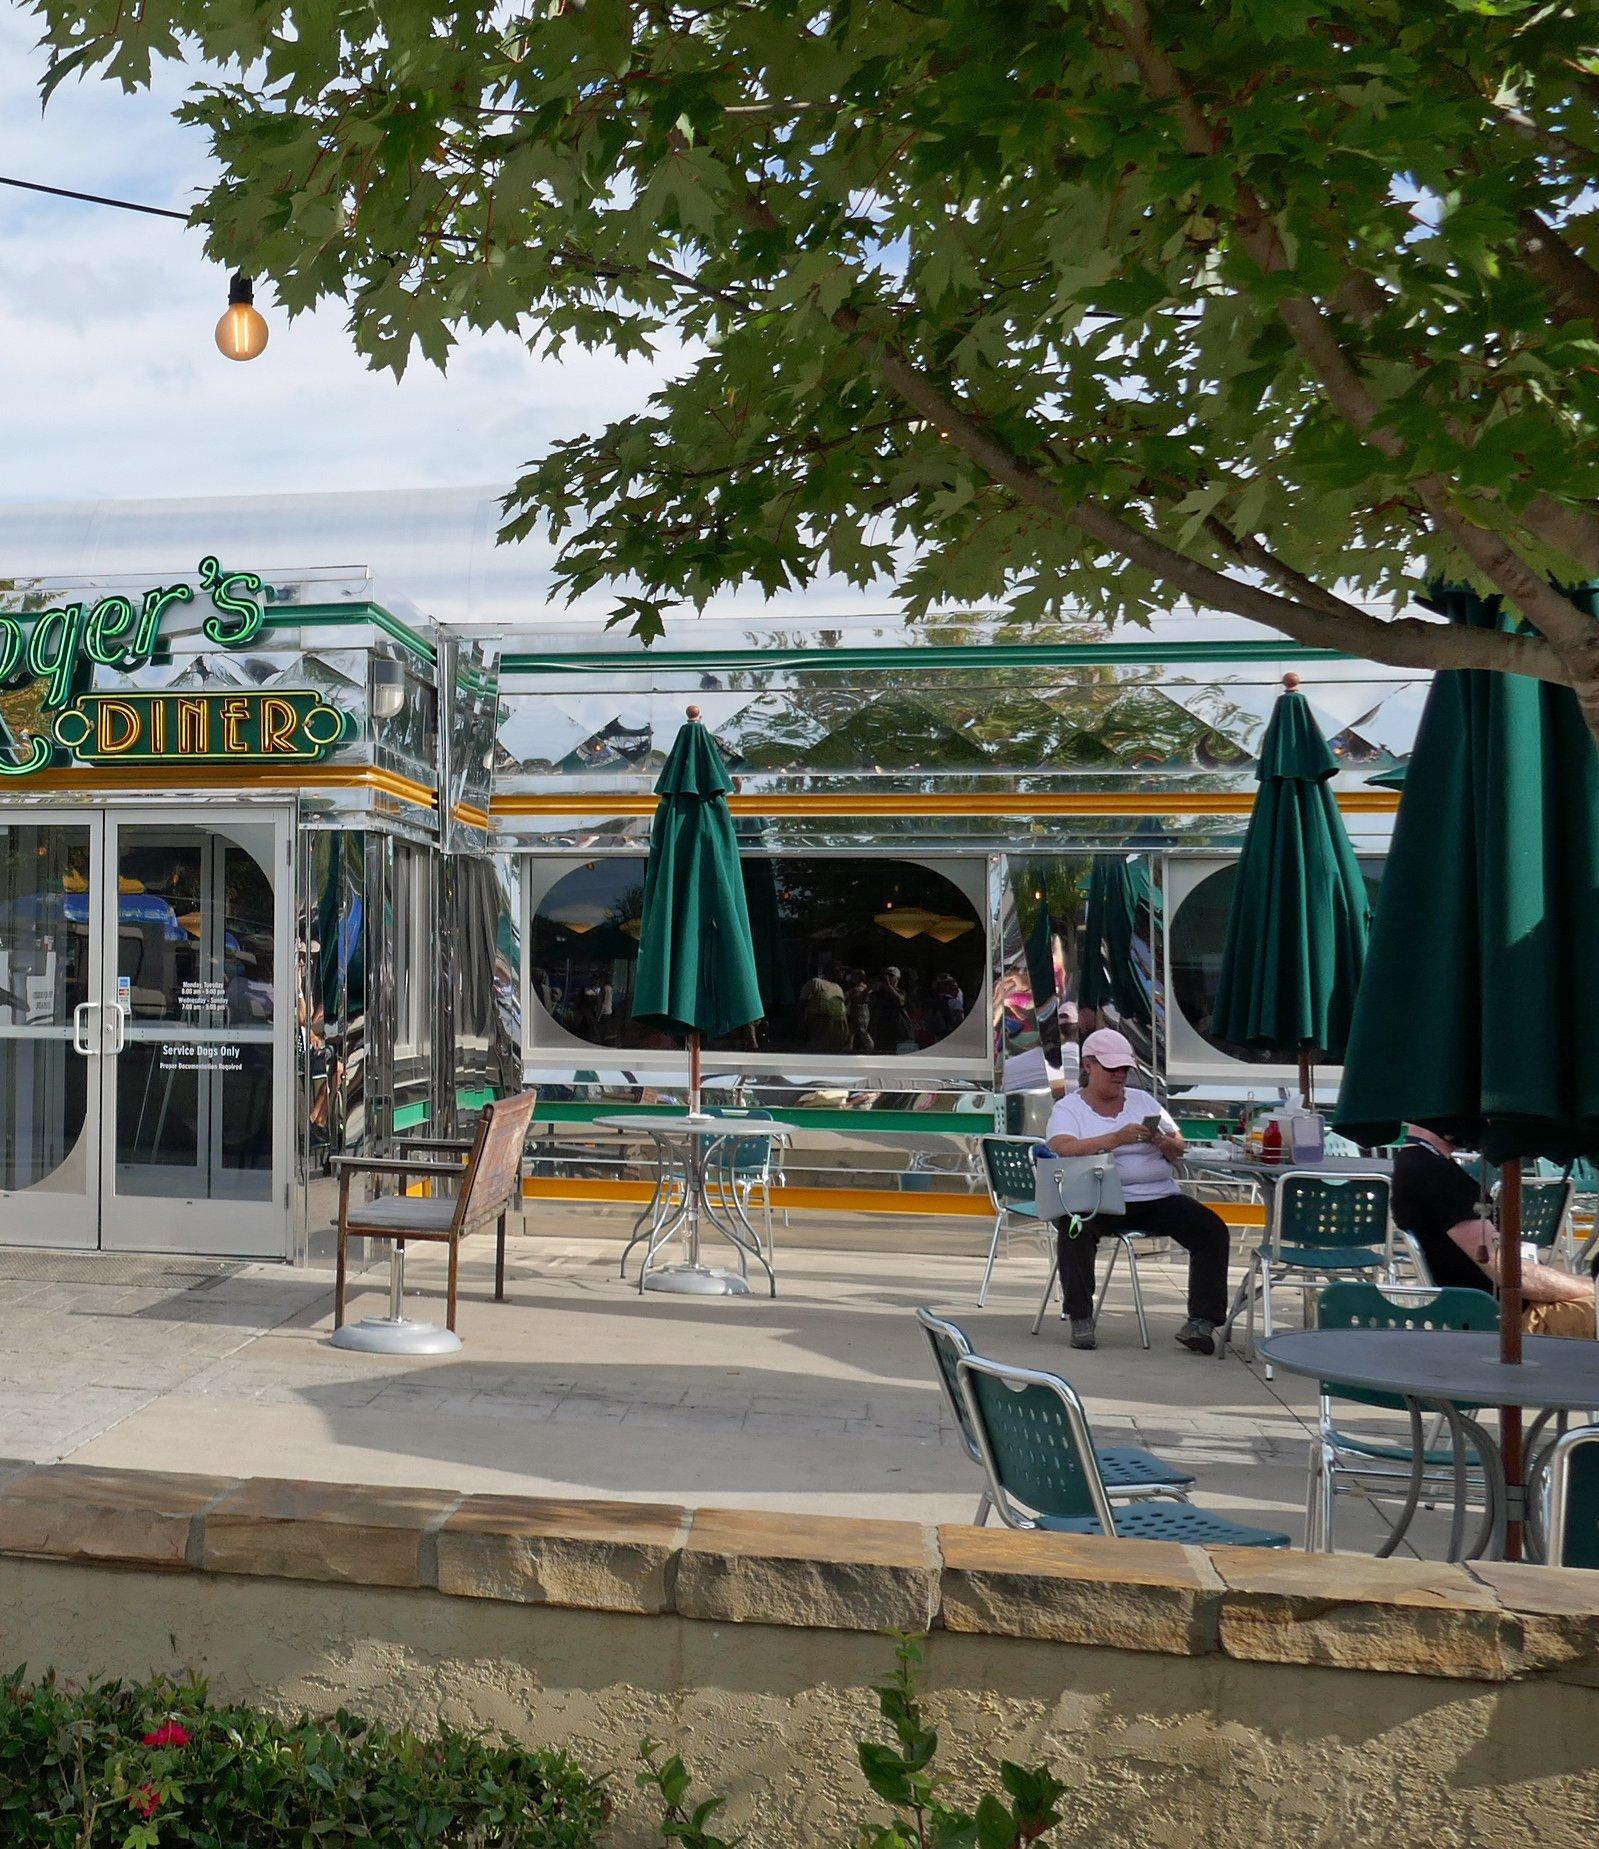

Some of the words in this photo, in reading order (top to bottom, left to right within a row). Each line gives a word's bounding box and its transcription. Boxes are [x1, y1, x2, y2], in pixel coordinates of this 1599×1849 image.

[96, 697, 300, 756] DINER
[162, 1045, 195, 1056] Service
[197, 1045, 218, 1058] Dogs
[220, 1046, 240, 1059] Only
